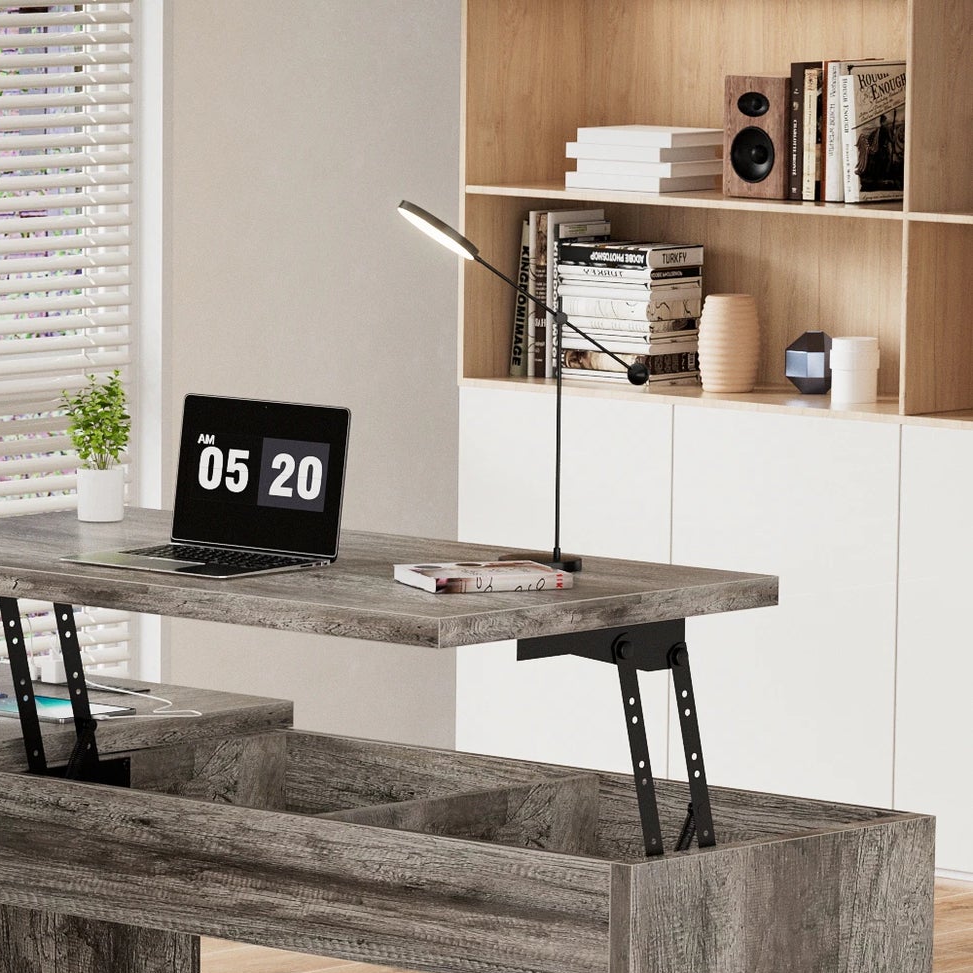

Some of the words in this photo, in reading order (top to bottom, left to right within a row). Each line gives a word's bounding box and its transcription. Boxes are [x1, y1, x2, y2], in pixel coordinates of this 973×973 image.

[589, 251, 624, 263] PHOTOSHOP
[624, 253, 645, 264] ADOBE
[197, 433, 215, 445] AM
[198, 446, 250, 493] 05
[268, 452, 323, 500] 20
